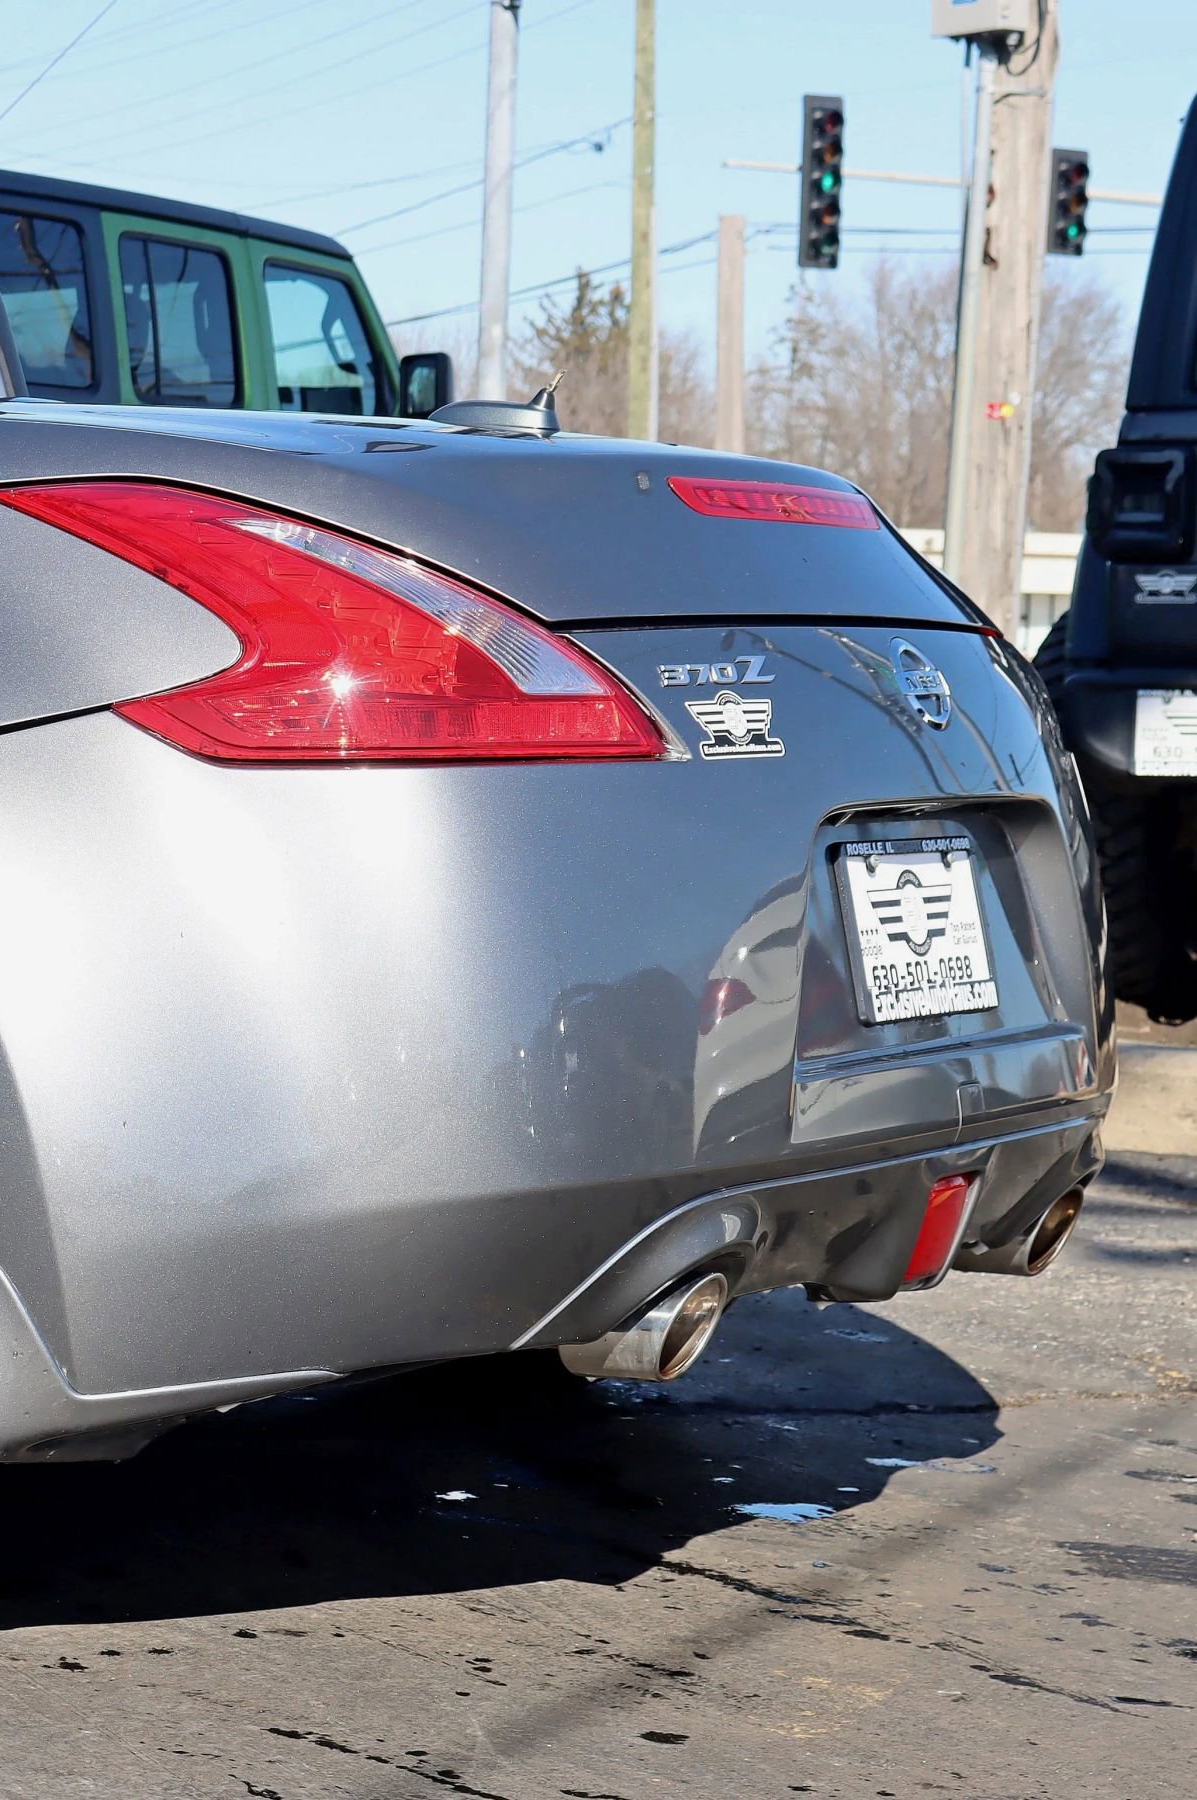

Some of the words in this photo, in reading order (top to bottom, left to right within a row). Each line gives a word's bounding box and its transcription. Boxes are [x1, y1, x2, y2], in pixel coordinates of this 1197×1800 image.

[658, 655, 777, 687] 370Z
[886, 840, 895, 853] IL
[921, 837, 971, 853] 630-501-0698
[872, 955, 973, 991] 630-501-0698
